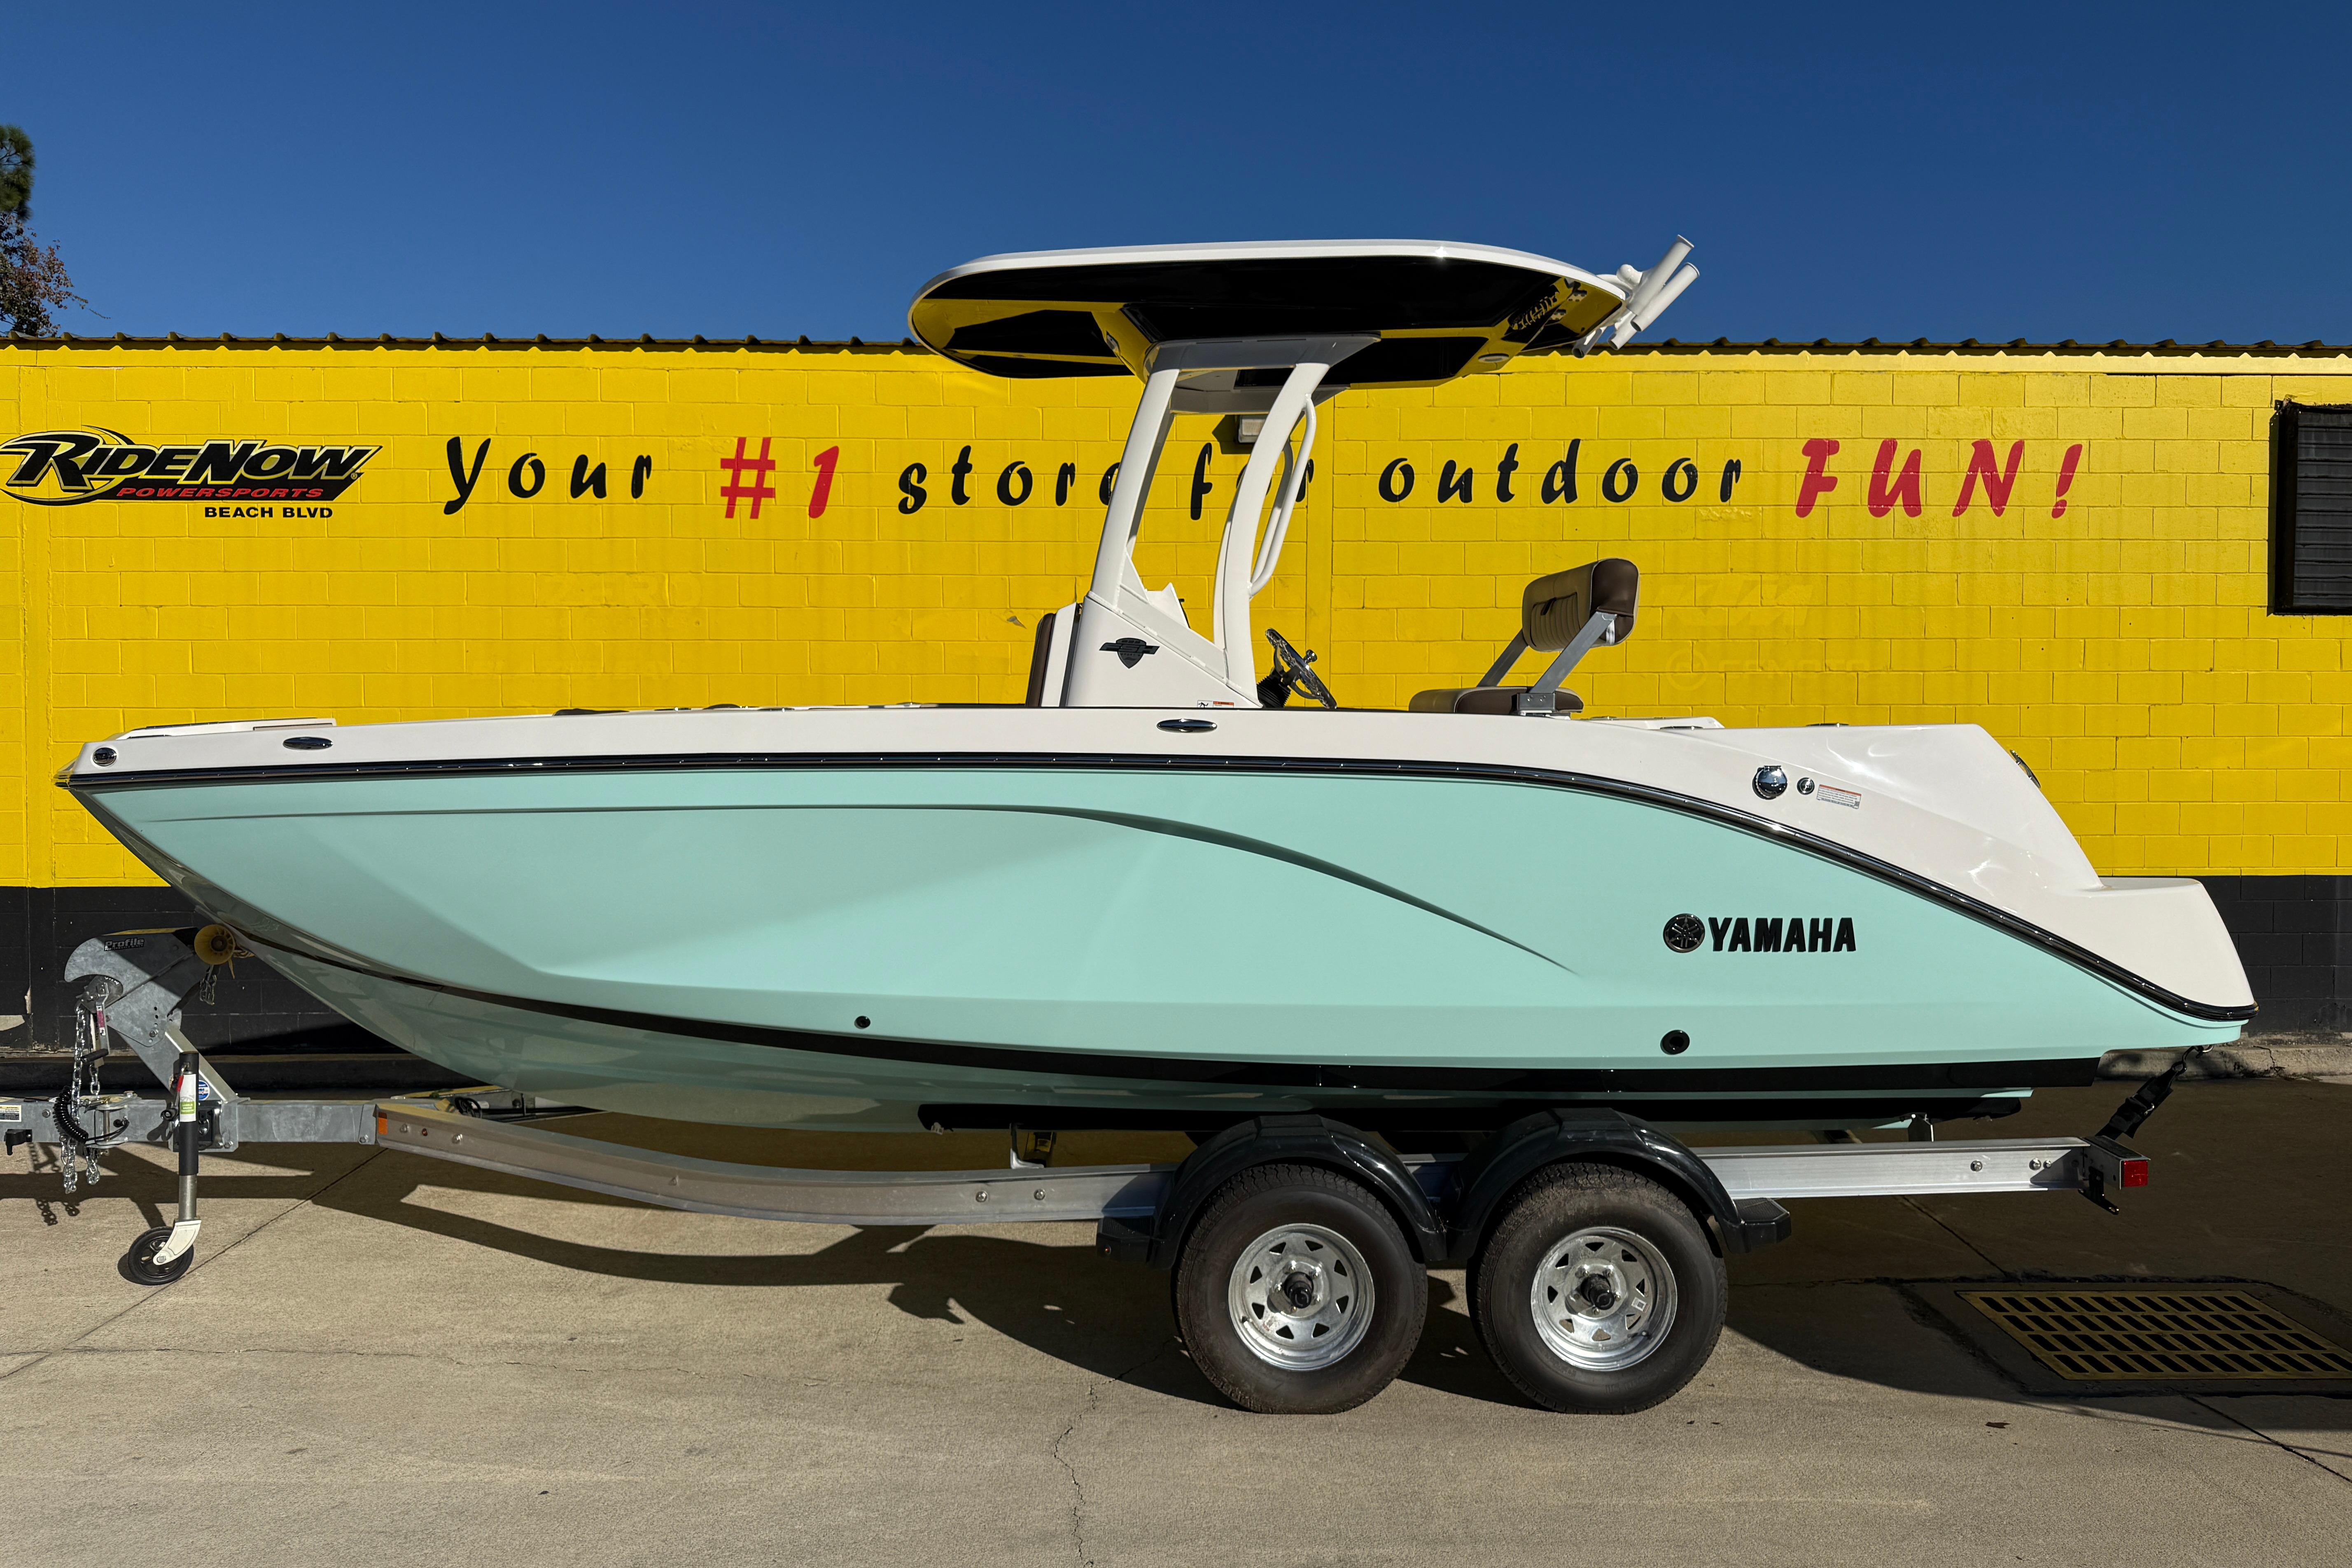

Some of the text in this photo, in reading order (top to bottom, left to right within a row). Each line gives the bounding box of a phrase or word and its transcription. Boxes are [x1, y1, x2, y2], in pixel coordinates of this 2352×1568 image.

[443, 436, 652, 515] your
[720, 437, 839, 519] #1
[1190, 443, 1314, 520] fr
[1379, 439, 1741, 504] outdoor
[1796, 439, 2082, 518] FUN!
[117, 488, 323, 497] POWERSPORTS
[205, 507, 333, 518] BEACH BLVD
[1708, 917, 1856, 952] YAMAHA
[105, 938, 144, 948] Profile
